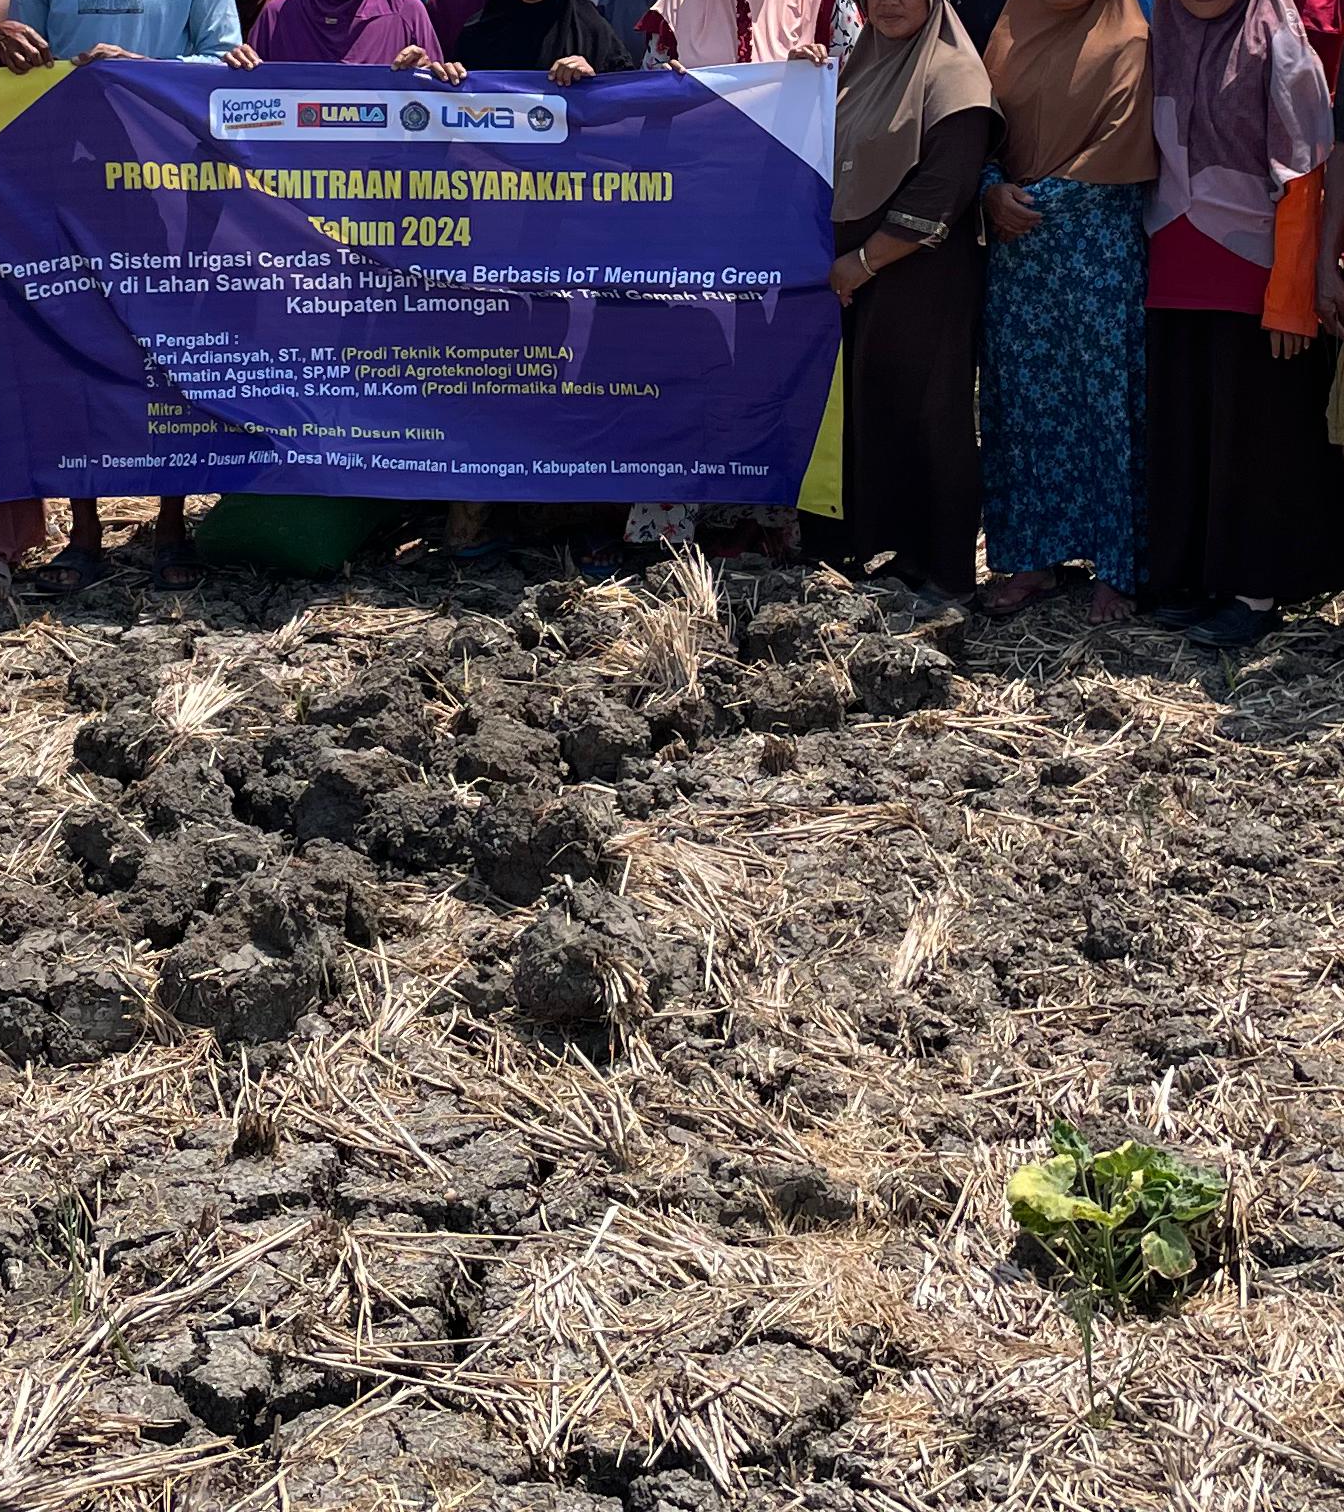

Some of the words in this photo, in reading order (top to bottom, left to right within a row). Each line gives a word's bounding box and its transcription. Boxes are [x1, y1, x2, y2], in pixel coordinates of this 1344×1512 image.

[222, 98, 281, 113] Kampus
[321, 105, 385, 122] UMLA
[222, 109, 287, 124] Merdeka
[441, 105, 515, 129] UMG
[105, 161, 242, 191] PROGRAM
[245, 168, 402, 200] KEMITRAAN
[409, 170, 586, 201] MASYARAKAT
[592, 172, 673, 202] (PKM)
[308, 215, 395, 246] Tahun
[401, 216, 471, 246] 2024
[109, 251, 181, 270] Sistem
[188, 250, 252, 272] Irigasi
[257, 250, 331, 268] Cerdas
[473, 265, 560, 284] Berbasis
[566, 266, 599, 283] IoT
[604, 266, 715, 288] Menunjang
[721, 267, 782, 285] Green
[119, 276, 139, 294] di
[145, 275, 209, 293] Lahan
[215, 273, 284, 292] Sawah
[290, 272, 353, 290] Tadah
[359, 271, 418, 292] Hujan
[286, 295, 397, 317] Kabupaten
[403, 294, 510, 316] Lamongan
[156, 332, 230, 349] Pengabdi
[181, 349, 274, 366] Ardiansyah,
[310, 348, 337, 361] MT.
[341, 347, 387, 363] (Prodi
[392, 346, 441, 360] Teknik
[445, 346, 520, 362] Komputer
[523, 346, 574, 362] UMLA)
[224, 368, 298, 385] Agustina,
[354, 364, 401, 380] (Prodi
[405, 363, 513, 380] Agroteknologi
[516, 363, 559, 379] UMG)
[240, 384, 299, 399] Shodiq,
[303, 383, 360, 398] S.Kom,
[363, 383, 418, 396] M.Kom
[421, 382, 468, 397] (Prodi
[472, 381, 557, 395] Informatika
[561, 381, 605, 395] Medis
[609, 382, 660, 399] UMLA)
[147, 402, 183, 417] Mitra
[148, 420, 218, 435] Kelompok
[302, 423, 347, 438] Ripah
[351, 426, 401, 439] Dusun
[405, 427, 445, 441] Klitih
[58, 454, 88, 469] Juni
[102, 453, 166, 468] Desember
[168, 452, 198, 467] 2024
[208, 451, 246, 466] Dusun
[248, 449, 283, 465] Klitih,
[286, 450, 322, 465] Desa
[325, 451, 368, 470] Wajik,
[371, 454, 447, 473] Kecamatan
[451, 459, 529, 477] Lamongan,
[532, 459, 607, 476] Kabupaten
[611, 459, 688, 477] Lamongan,
[691, 461, 726, 476] Jawa
[729, 461, 769, 476] Timur
